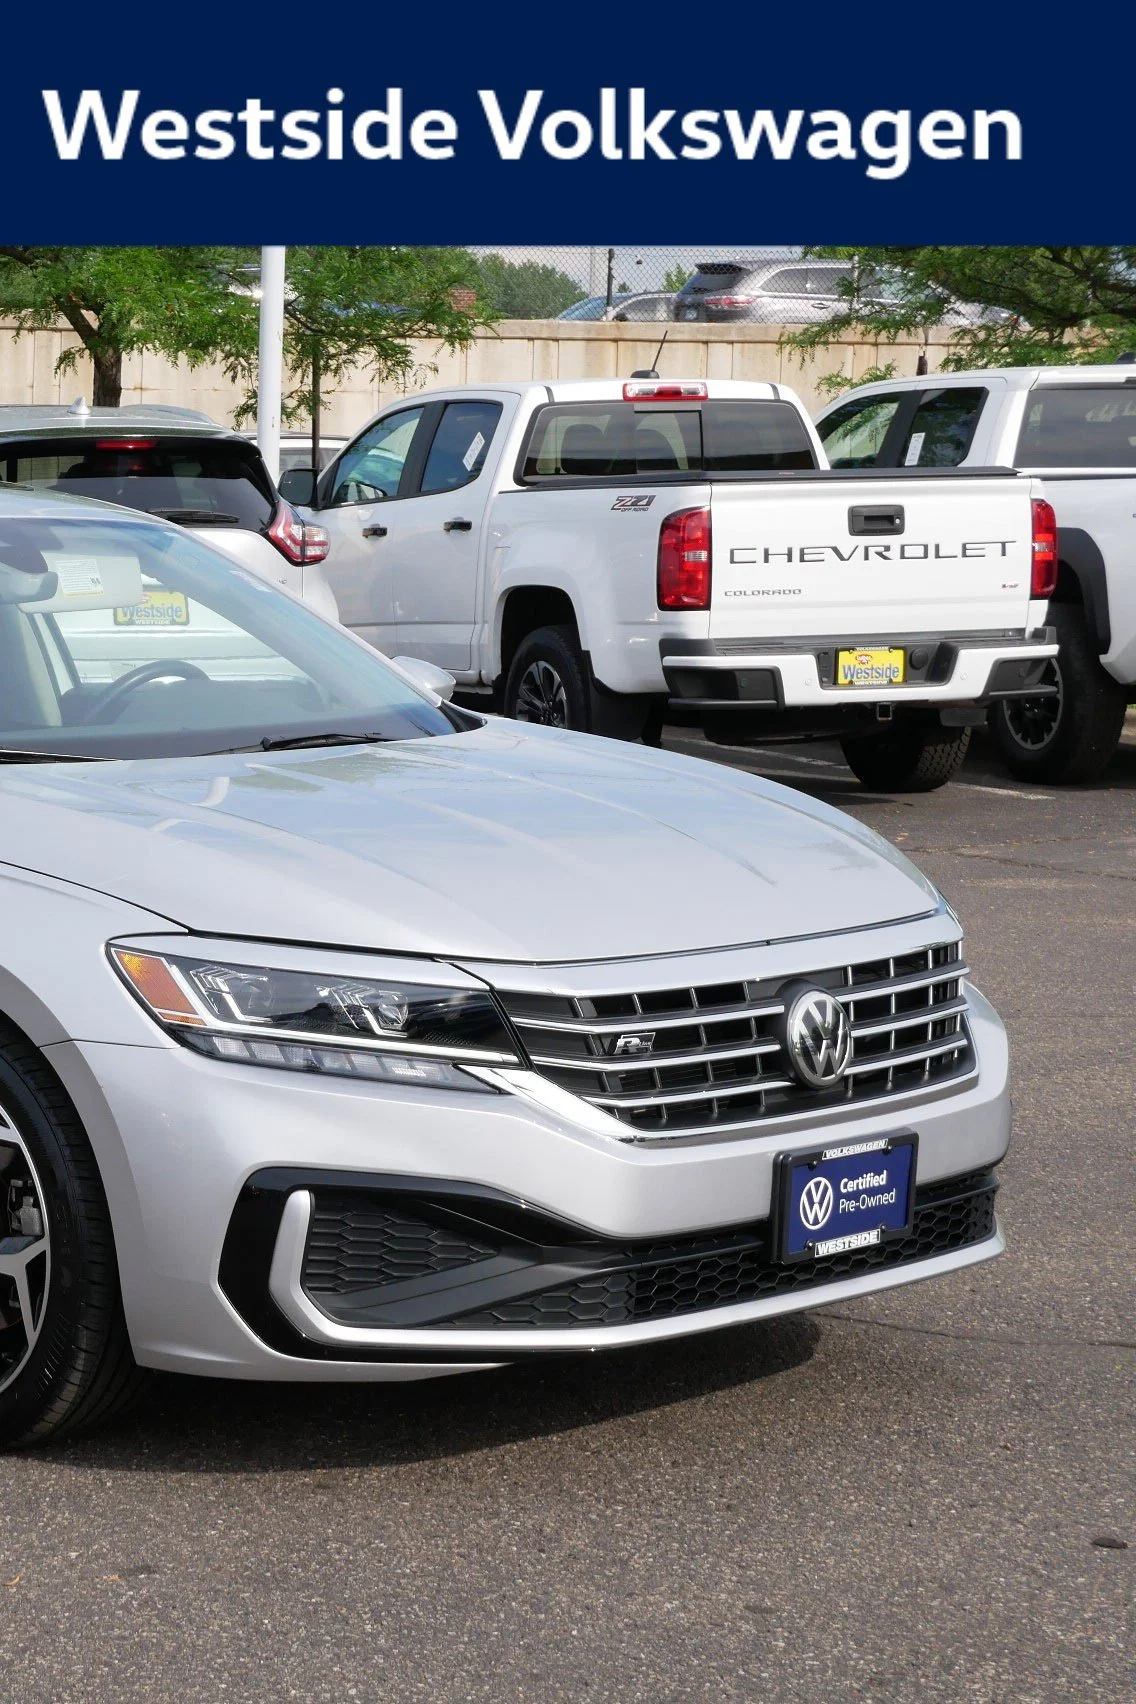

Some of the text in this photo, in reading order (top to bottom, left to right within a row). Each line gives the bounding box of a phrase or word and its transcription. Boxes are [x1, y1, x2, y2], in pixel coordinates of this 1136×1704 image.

[611, 495, 656, 510] Z71
[729, 541, 1017, 564] CHEVROLET
[724, 588, 802, 597] COLORADO
[121, 603, 182, 618] Westside
[843, 664, 899, 679] Westside
[825, 1140, 887, 1159] VOLKSWAGEN
[840, 1169, 887, 1194] Certified
[839, 1188, 896, 1214] Pre-Owned
[817, 1230, 879, 1255] WESTSIDE
